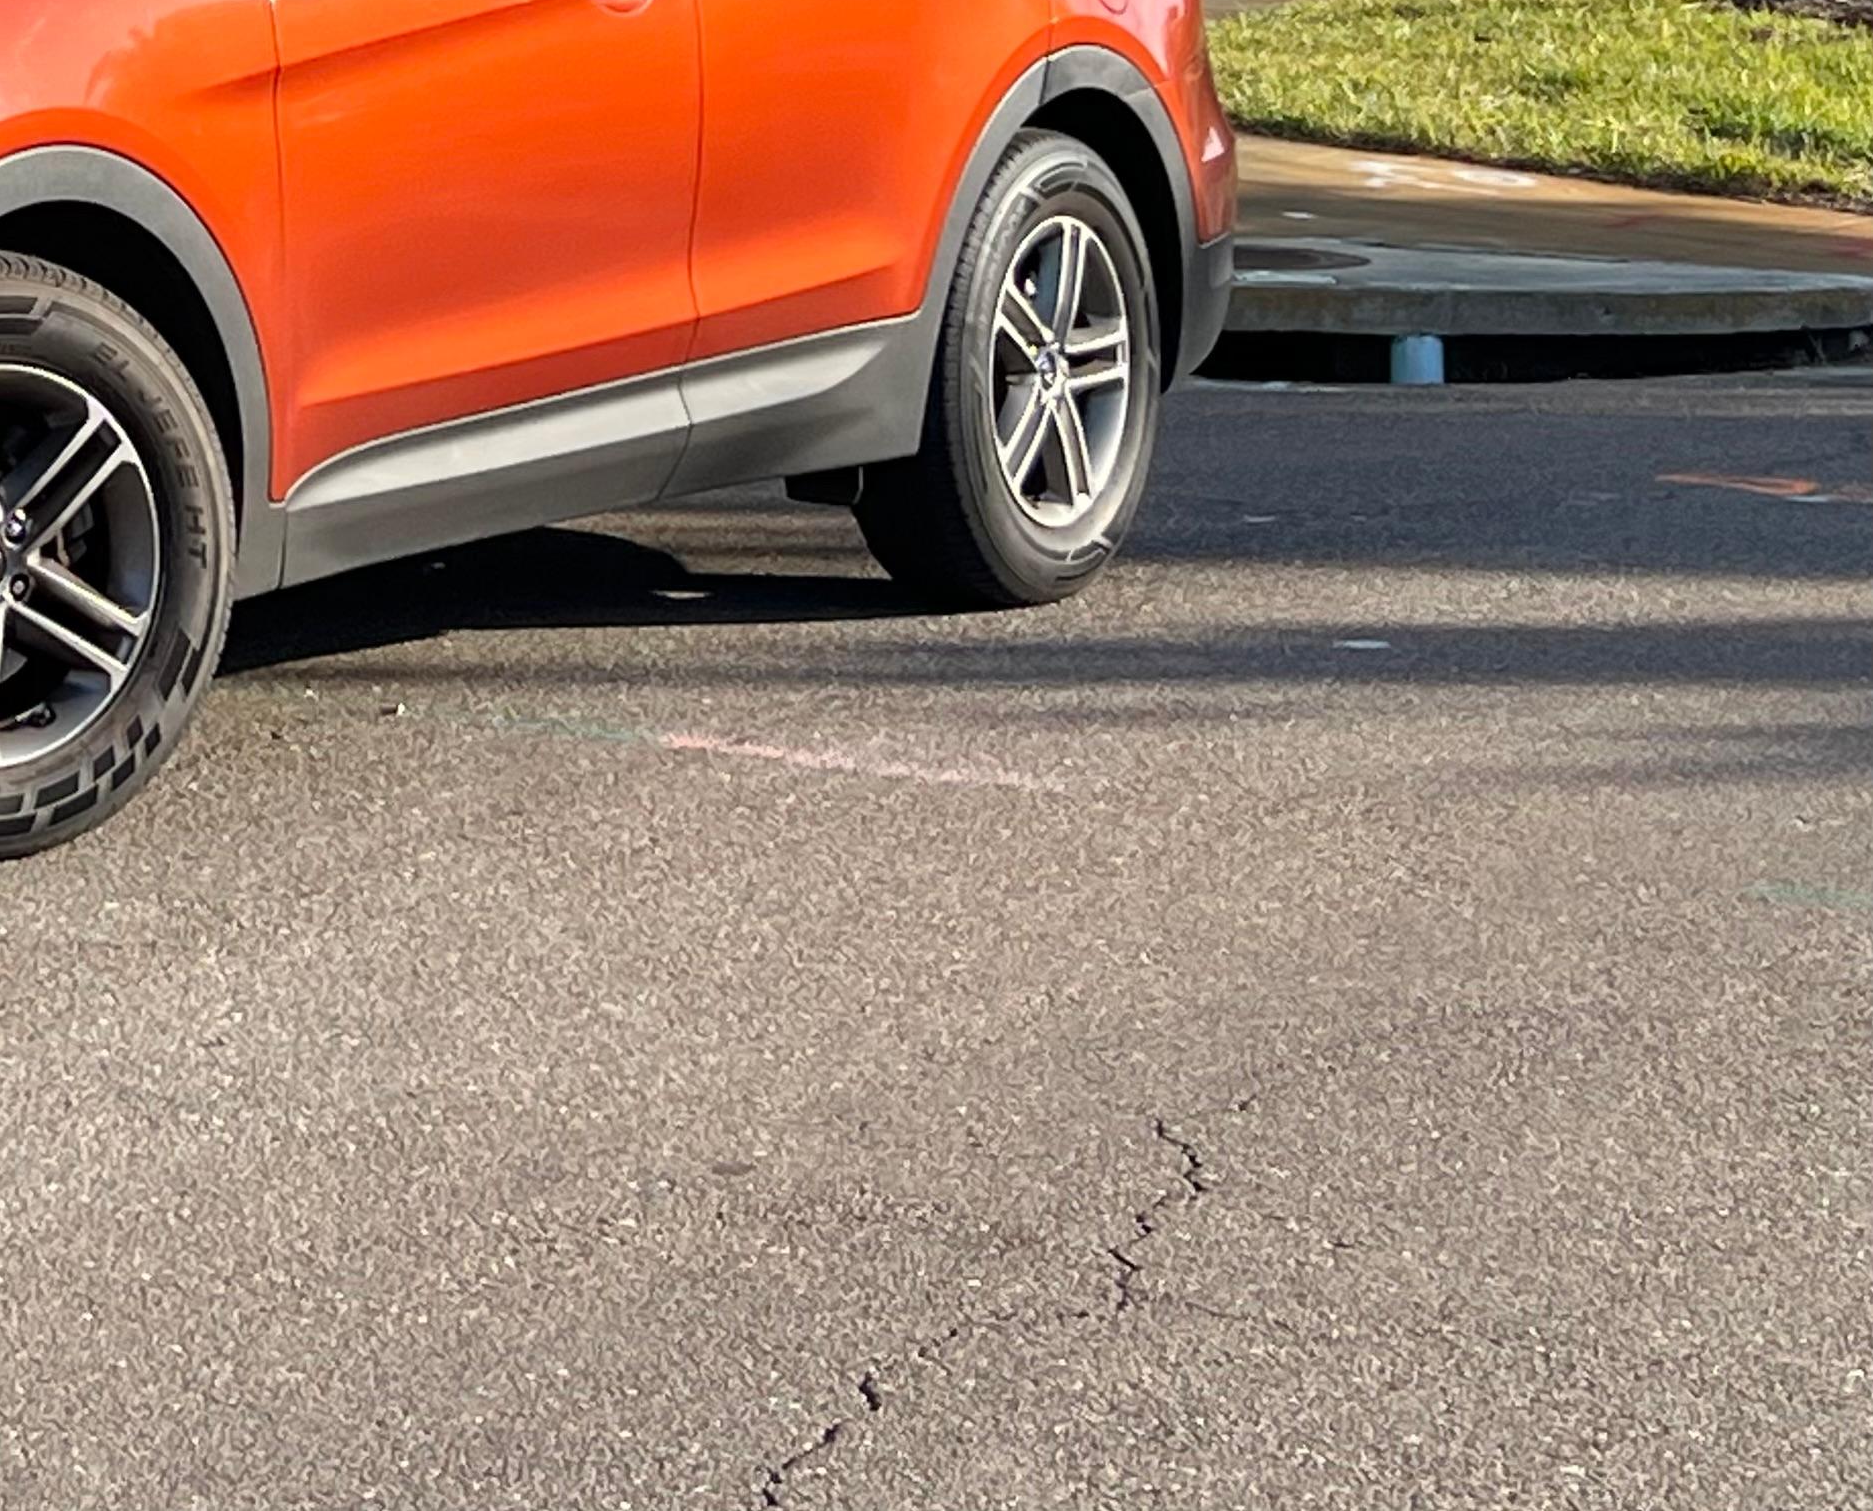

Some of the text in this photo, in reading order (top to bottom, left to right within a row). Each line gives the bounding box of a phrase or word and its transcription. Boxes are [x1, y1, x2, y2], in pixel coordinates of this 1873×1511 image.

[91, 341, 208, 570] EL JEFE HT
